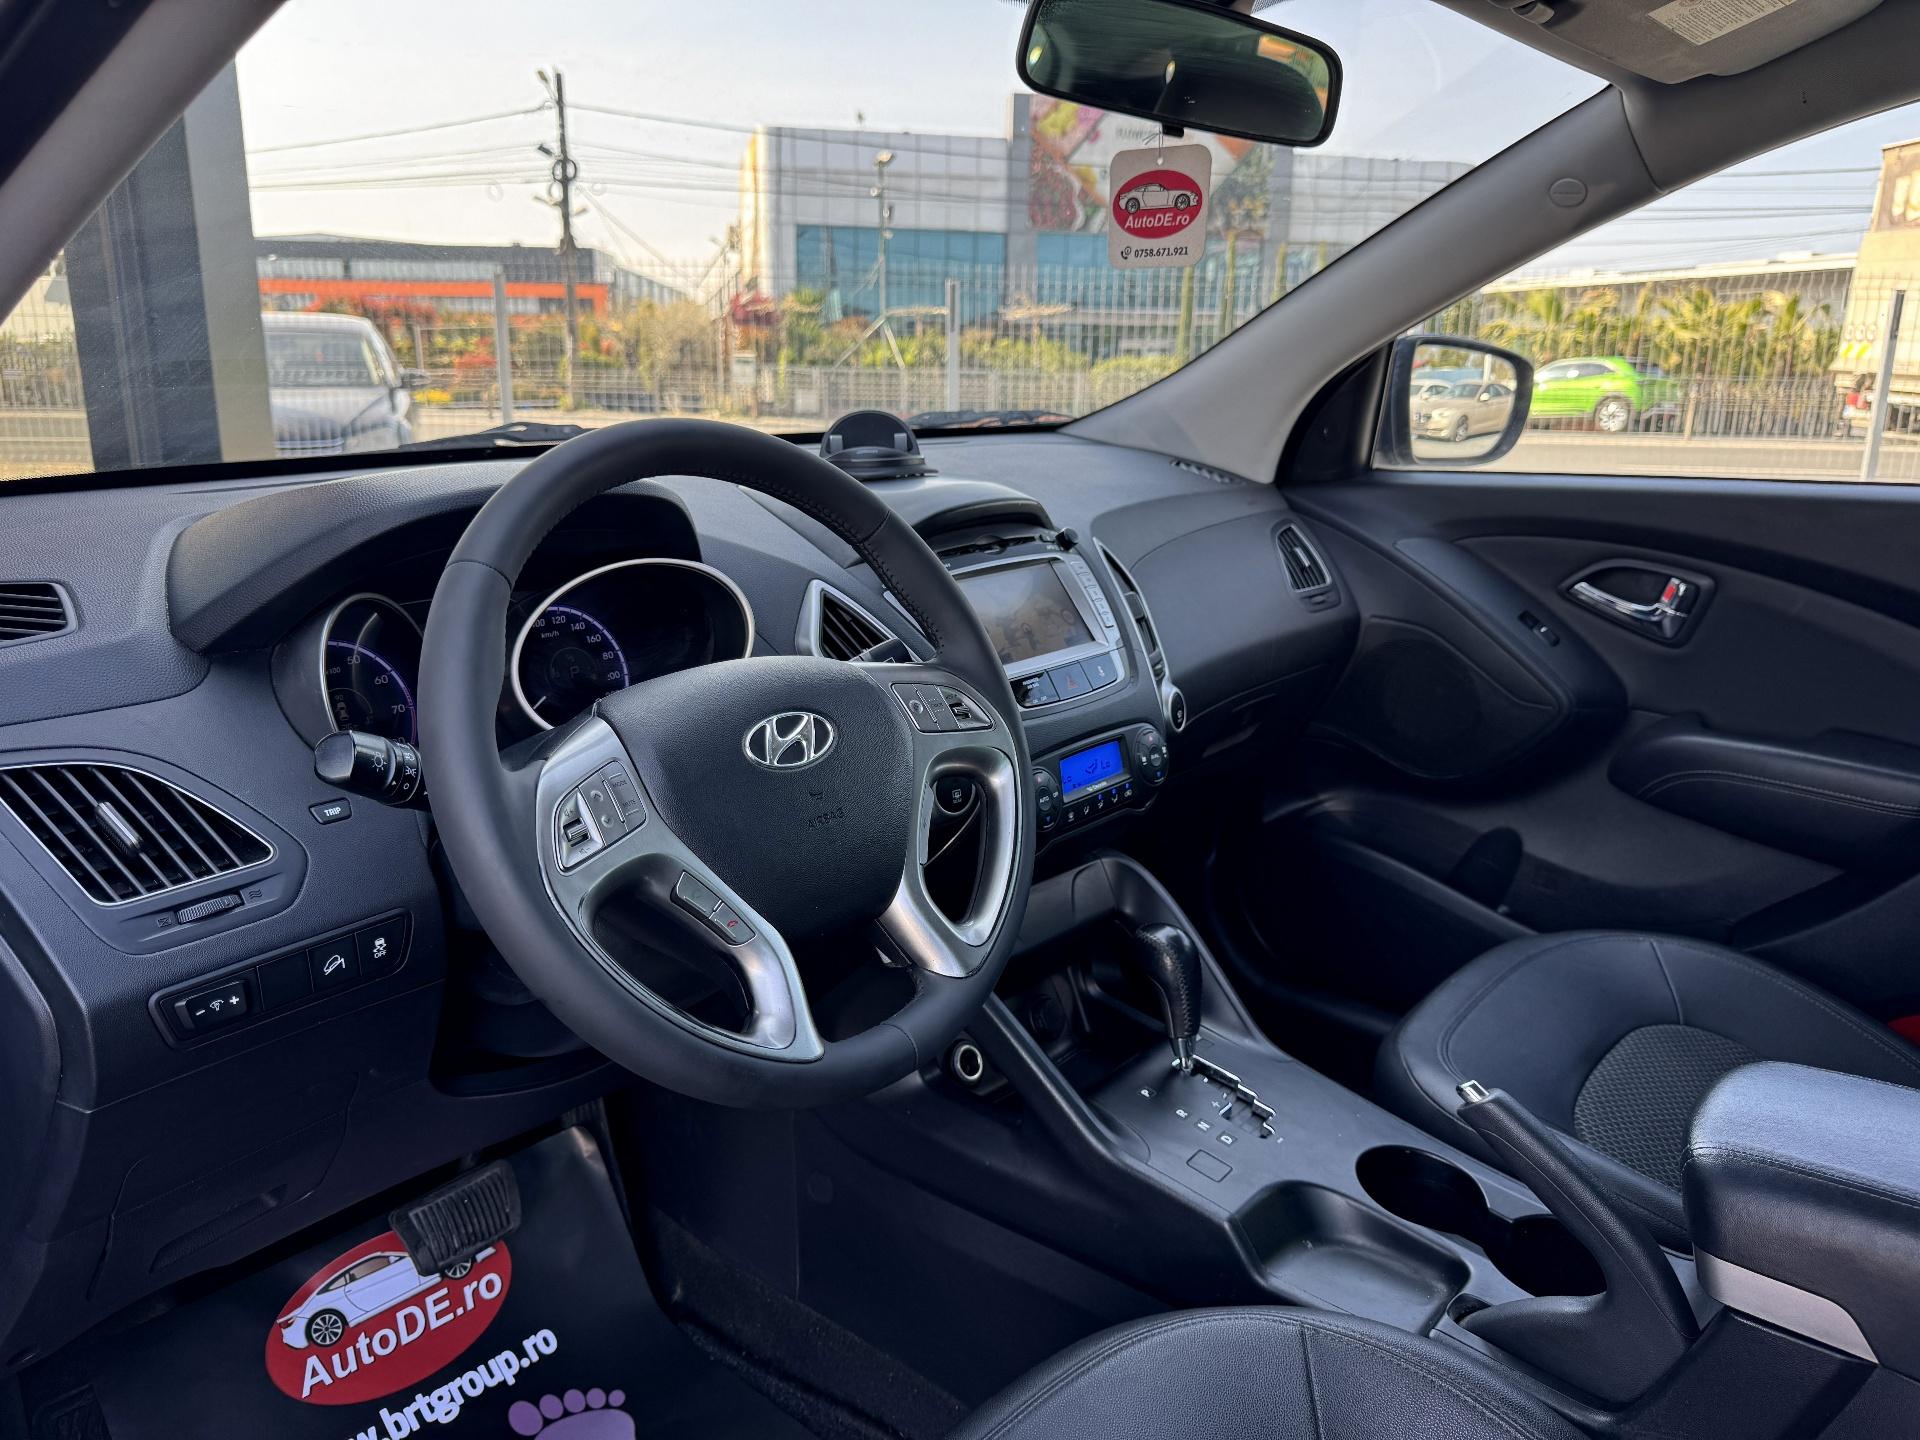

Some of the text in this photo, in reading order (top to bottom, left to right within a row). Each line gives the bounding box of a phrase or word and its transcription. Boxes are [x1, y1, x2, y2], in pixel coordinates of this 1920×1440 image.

[1124, 212, 1190, 229] AutoDE.ro
[1134, 246, 1189, 259] 0758.671.921
[551, 615, 566, 625] 120
[570, 621, 586, 632] 140
[540, 630, 560, 639] km/h
[586, 633, 602, 644] 160
[347, 655, 361, 665] 50
[374, 674, 389, 685] 60
[391, 704, 406, 714] 70
[323, 806, 341, 817] TRIP
[374, 950, 387, 959] OFF
[1140, 1089, 1150, 1098] P
[1175, 1108, 1188, 1119] R
[1197, 1121, 1210, 1131] N
[1220, 1135, 1233, 1145] D
[301, 1272, 503, 1398] AutoDE.ro
